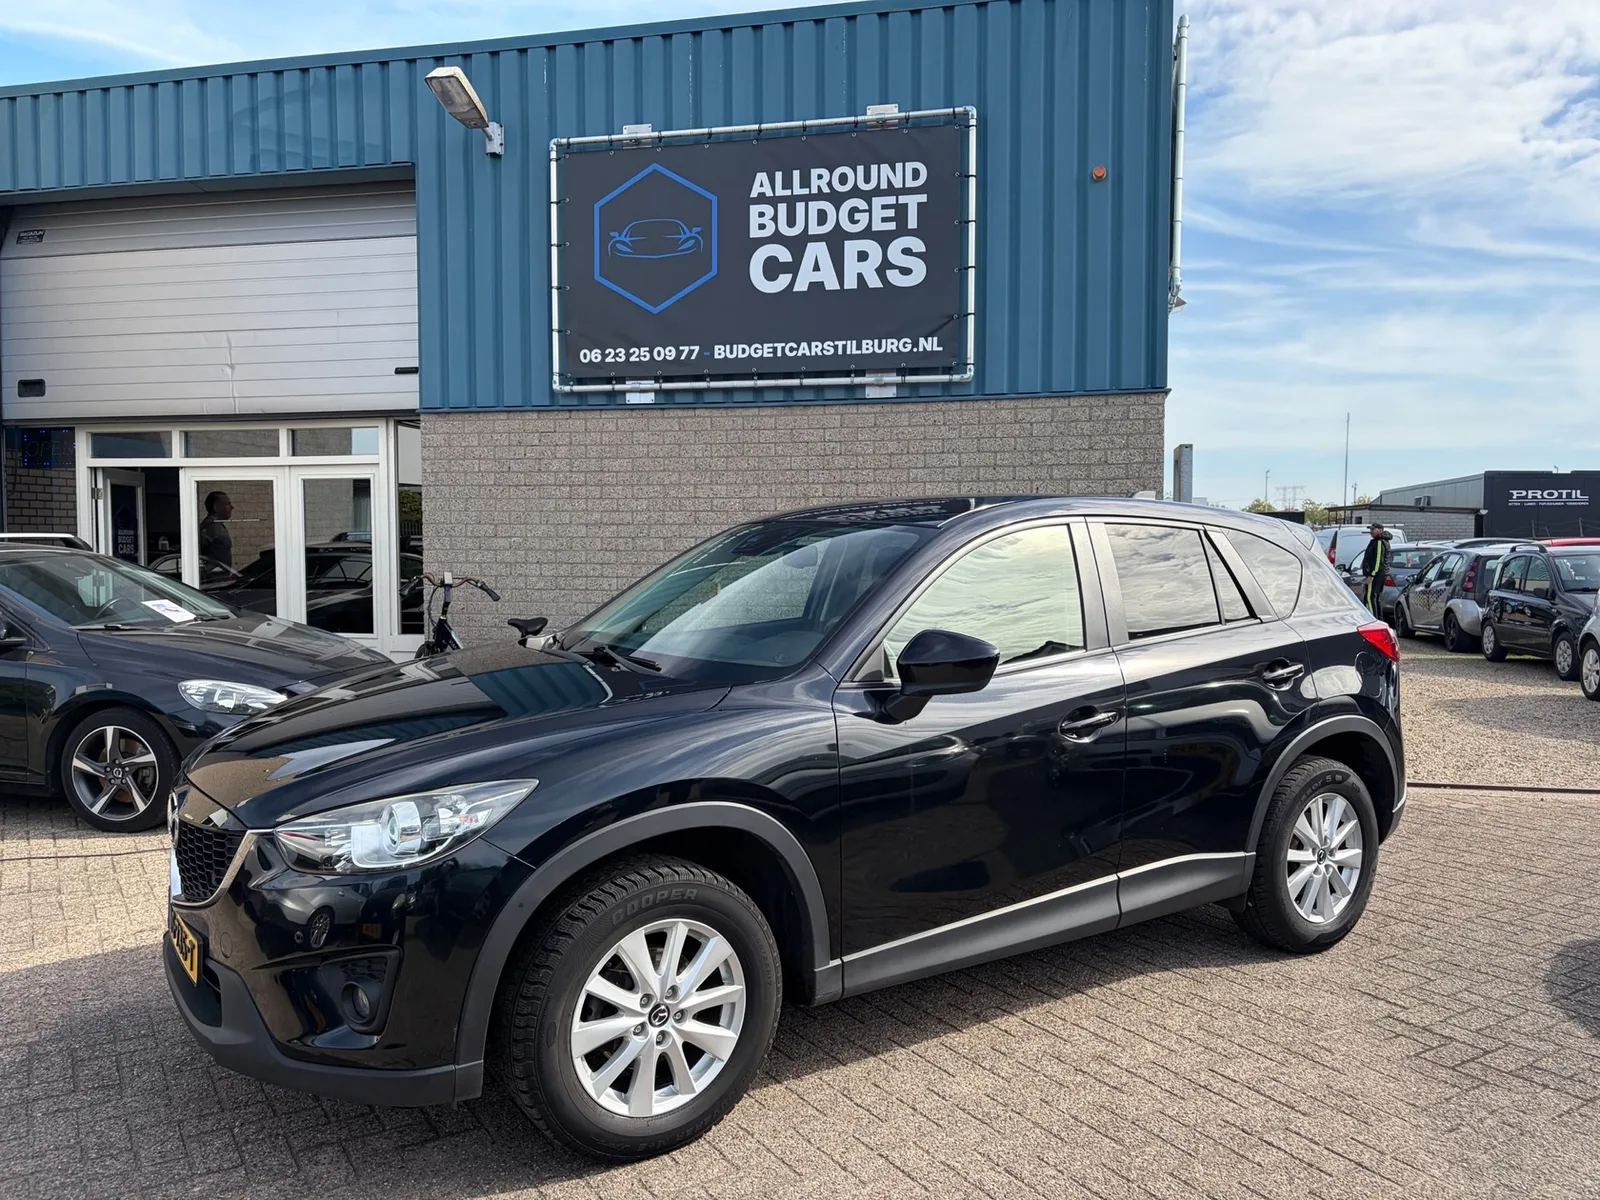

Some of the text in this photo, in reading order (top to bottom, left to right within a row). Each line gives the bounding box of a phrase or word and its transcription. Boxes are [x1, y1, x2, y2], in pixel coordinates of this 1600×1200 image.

[750, 161, 928, 198] ALLROUND
[749, 194, 928, 238] BUDGET
[749, 236, 927, 294] CARS
[579, 349, 602, 363] 06
[604, 348, 626, 363] 23
[629, 347, 651, 362] 25
[653, 346, 676, 361] 09
[679, 345, 700, 360] 77
[714, 336, 943, 359] BUDGETCARSTILBURG.NL
[1509, 489, 1590, 499] PROTIL
[118, 543, 135, 554] CARS
[611, 888, 698, 926] COOPER
